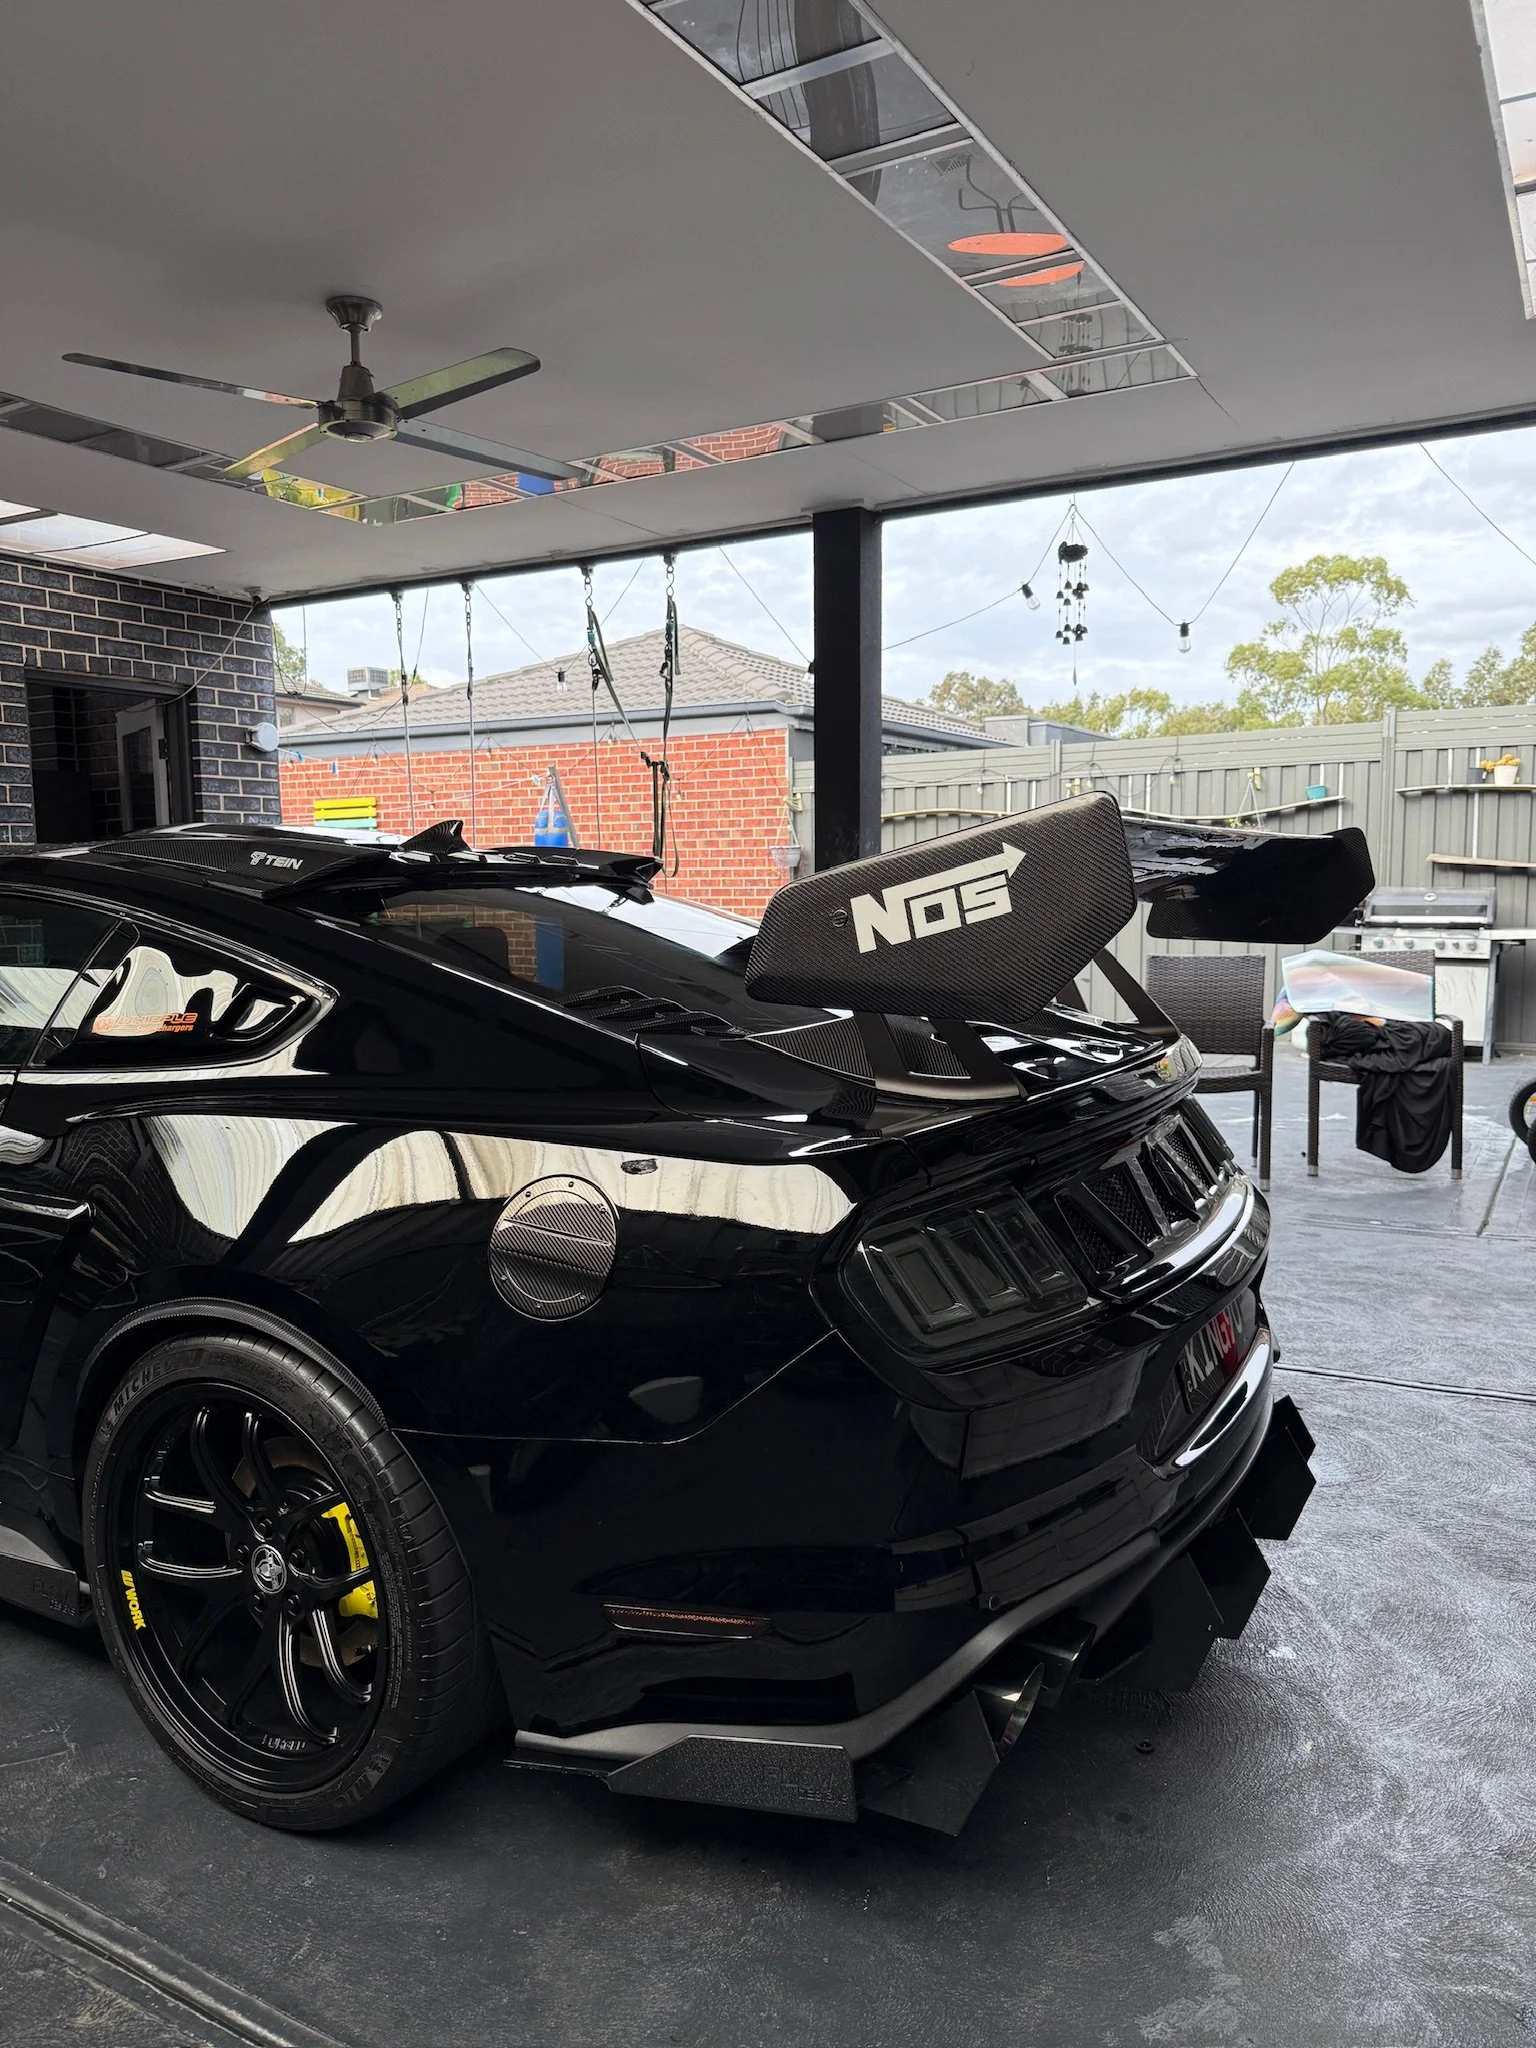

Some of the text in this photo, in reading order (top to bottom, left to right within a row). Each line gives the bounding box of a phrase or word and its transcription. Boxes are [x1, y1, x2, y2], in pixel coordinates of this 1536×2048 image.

[265, 854, 303, 870] TEIN
[850, 870, 1014, 954] NOS
[125, 1588, 147, 1630] WORK
